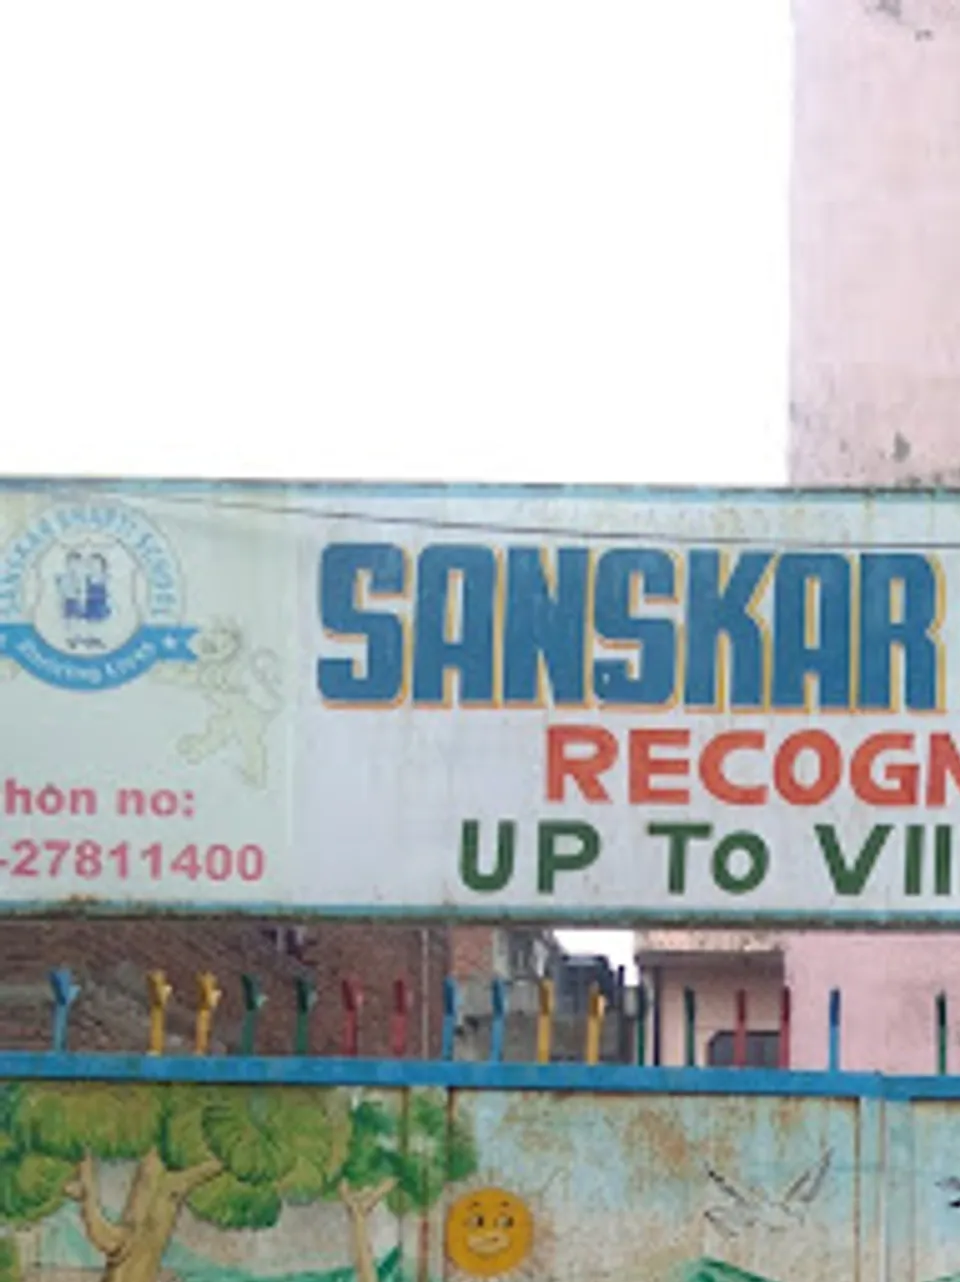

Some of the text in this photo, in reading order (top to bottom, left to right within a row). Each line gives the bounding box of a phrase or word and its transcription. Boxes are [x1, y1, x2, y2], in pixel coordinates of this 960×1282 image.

[317, 542, 947, 714] SANSKAR
[117, 788, 196, 818] no:
[459, 819, 601, 894] UP
